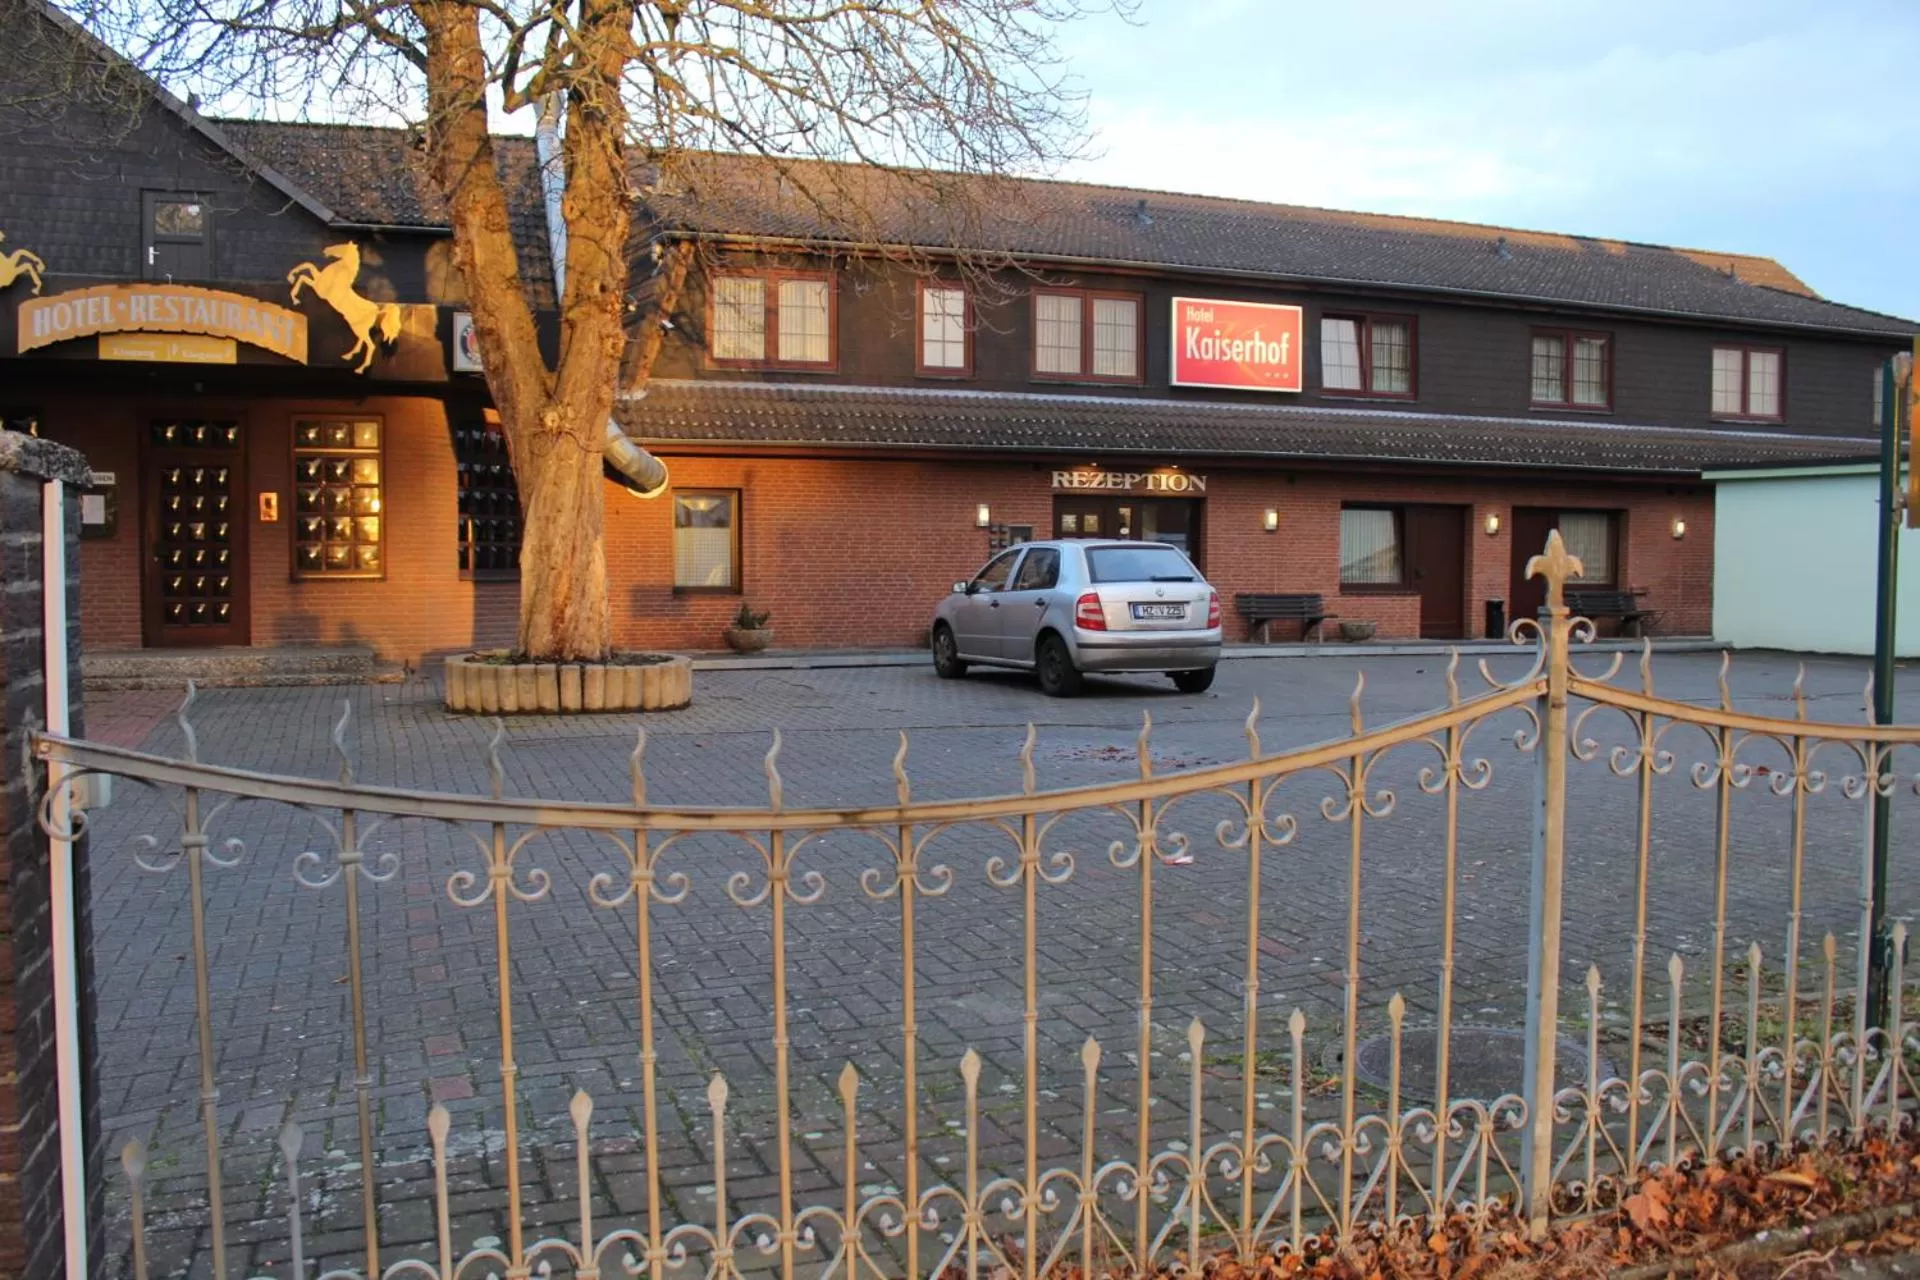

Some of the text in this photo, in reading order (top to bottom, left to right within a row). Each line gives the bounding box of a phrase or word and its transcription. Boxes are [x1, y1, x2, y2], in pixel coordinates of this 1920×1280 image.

[34, 294, 296, 348] HOTEL RESTAURANT
[1186, 305, 1215, 323] Hotel
[1186, 326, 1291, 366] Kaiserhof
[1051, 470, 1208, 492] REZEPTION
